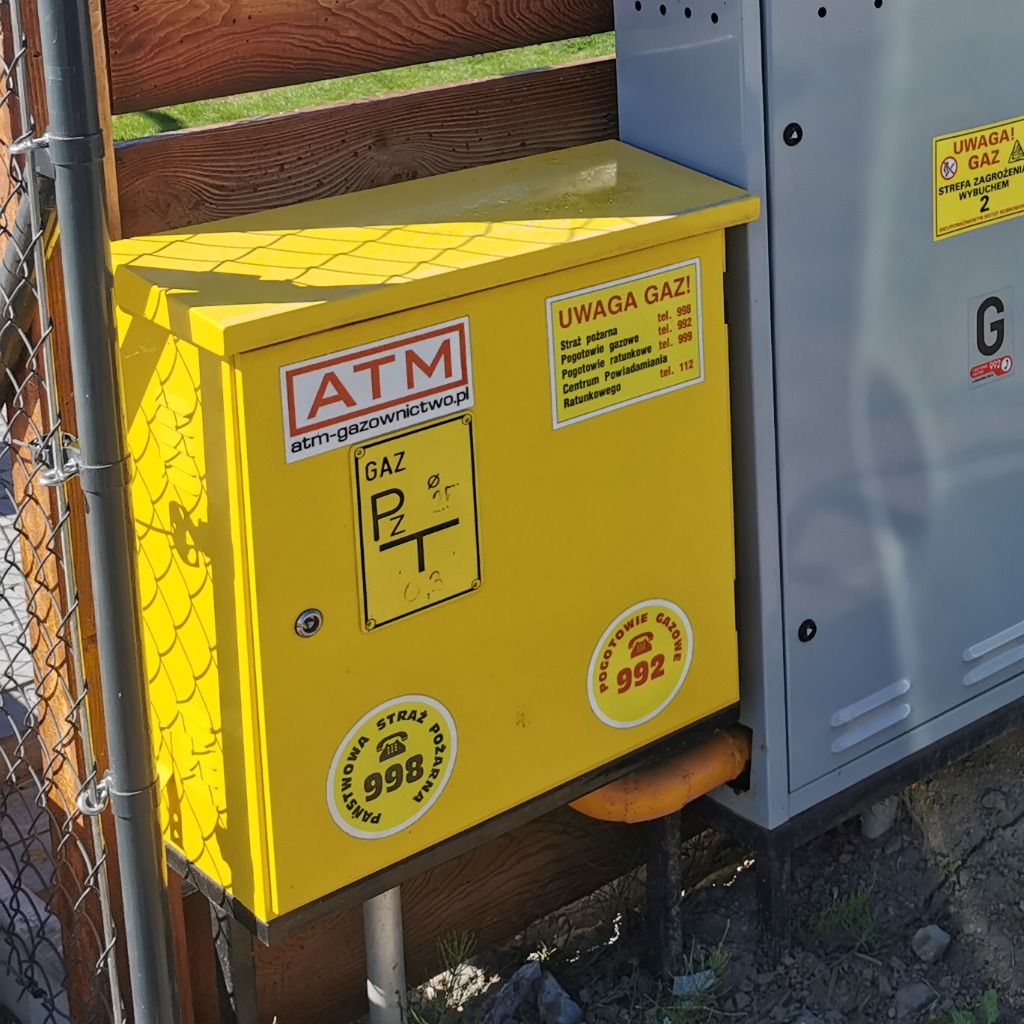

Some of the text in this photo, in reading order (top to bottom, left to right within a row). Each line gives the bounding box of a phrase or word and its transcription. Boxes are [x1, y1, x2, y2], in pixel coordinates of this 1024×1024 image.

[953, 127, 1014, 154] UWAGA!
[968, 149, 1000, 170] GAZ
[938, 180, 971, 196] STREFA
[959, 179, 1009, 200] WYBUCHEM
[980, 195, 990, 213] 2
[558, 275, 691, 329] UWAGA GAZ!
[976, 296, 1005, 356] G
[560, 304, 691, 351] Straż pożarna tel. 998
[561, 317, 692, 365] Pogotowie gazowe tel. 992
[307, 338, 453, 420] ATM
[562, 331, 693, 379] Pogotowie ratunkowe tel. 999
[563, 354, 668, 395] Centrum Powiadamiania
[564, 359, 694, 409] Ratunkowego tel. 112
[291, 387, 470, 454] atm-gazownictwo.pl
[365, 451, 406, 481] GAZ
[655, 612, 682, 662] GAZOWE
[616, 653, 665, 694] 992
[341, 710, 446, 824] PAŃSTWOWA STRAŻ POŻARNA
[363, 753, 424, 803] 998
